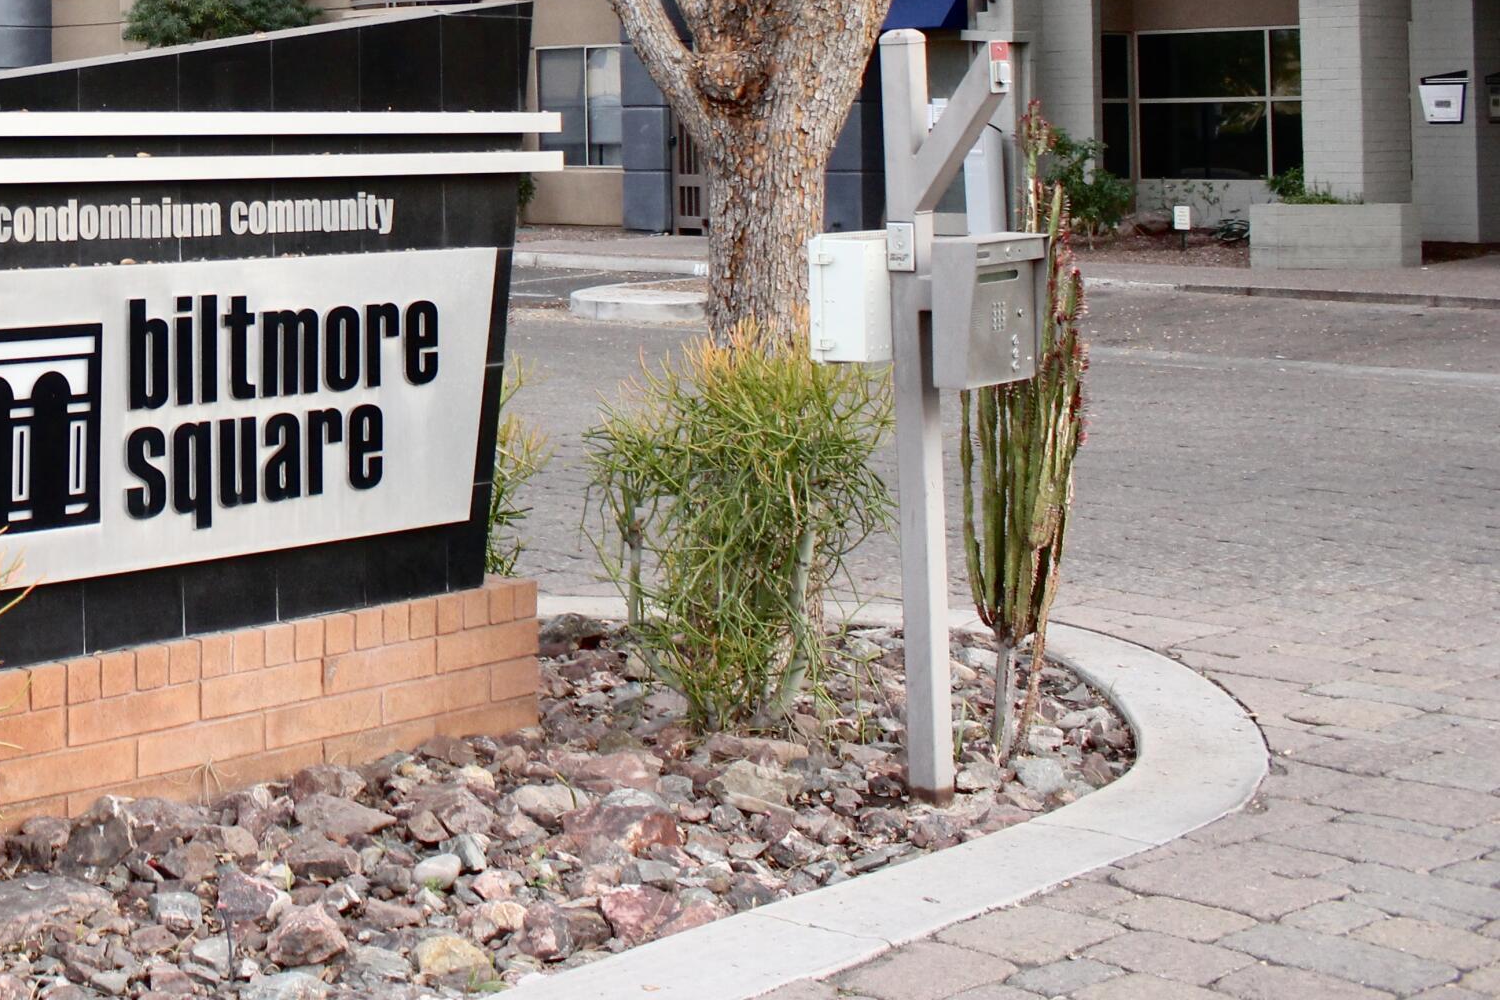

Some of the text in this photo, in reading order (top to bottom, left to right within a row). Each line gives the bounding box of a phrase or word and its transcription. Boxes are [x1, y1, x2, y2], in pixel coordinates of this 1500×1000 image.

[229, 191, 395, 236] community
[128, 294, 439, 411] biltmore
[124, 403, 384, 530] square
